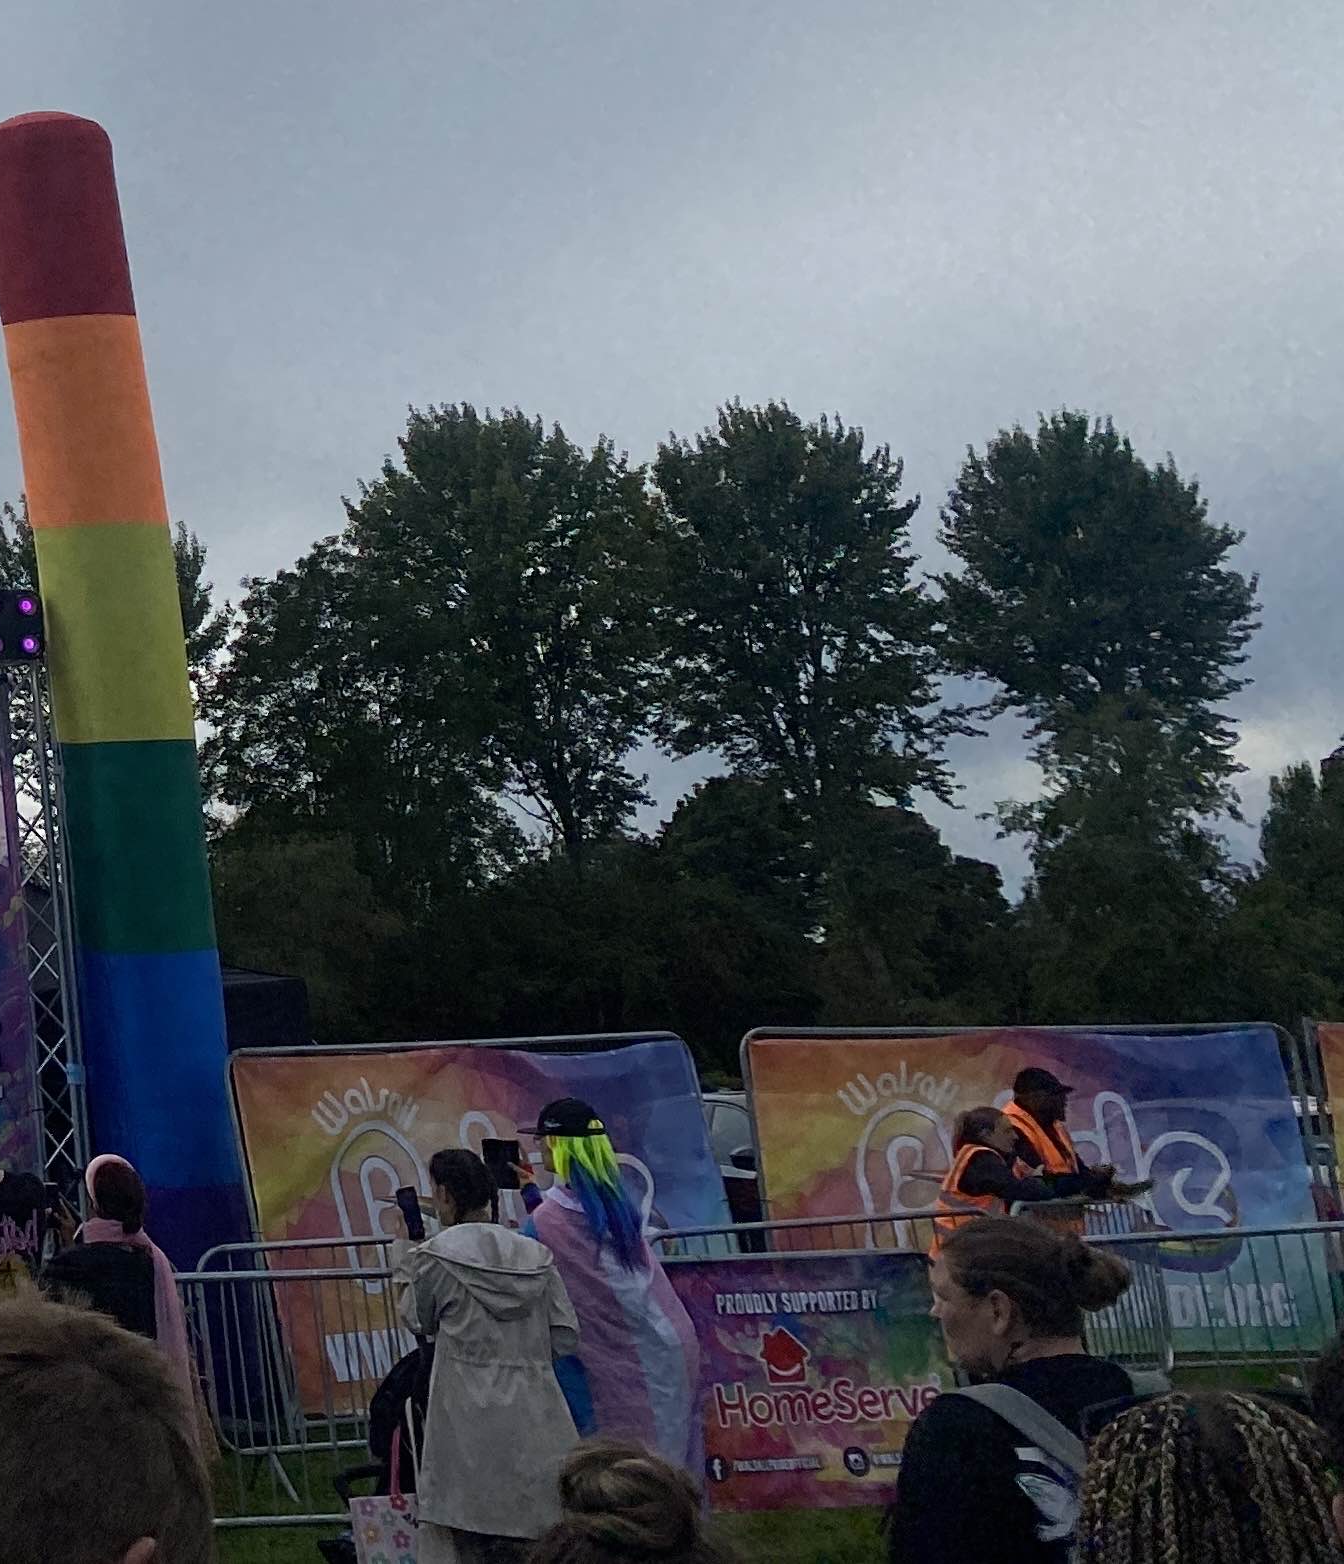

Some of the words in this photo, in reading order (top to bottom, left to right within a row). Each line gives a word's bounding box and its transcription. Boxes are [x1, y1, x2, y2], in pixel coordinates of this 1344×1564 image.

[715, 1292, 778, 1315] PROUDLY
[780, 1290, 859, 1313] SUPPORTED
[861, 1288, 878, 1310] BY
